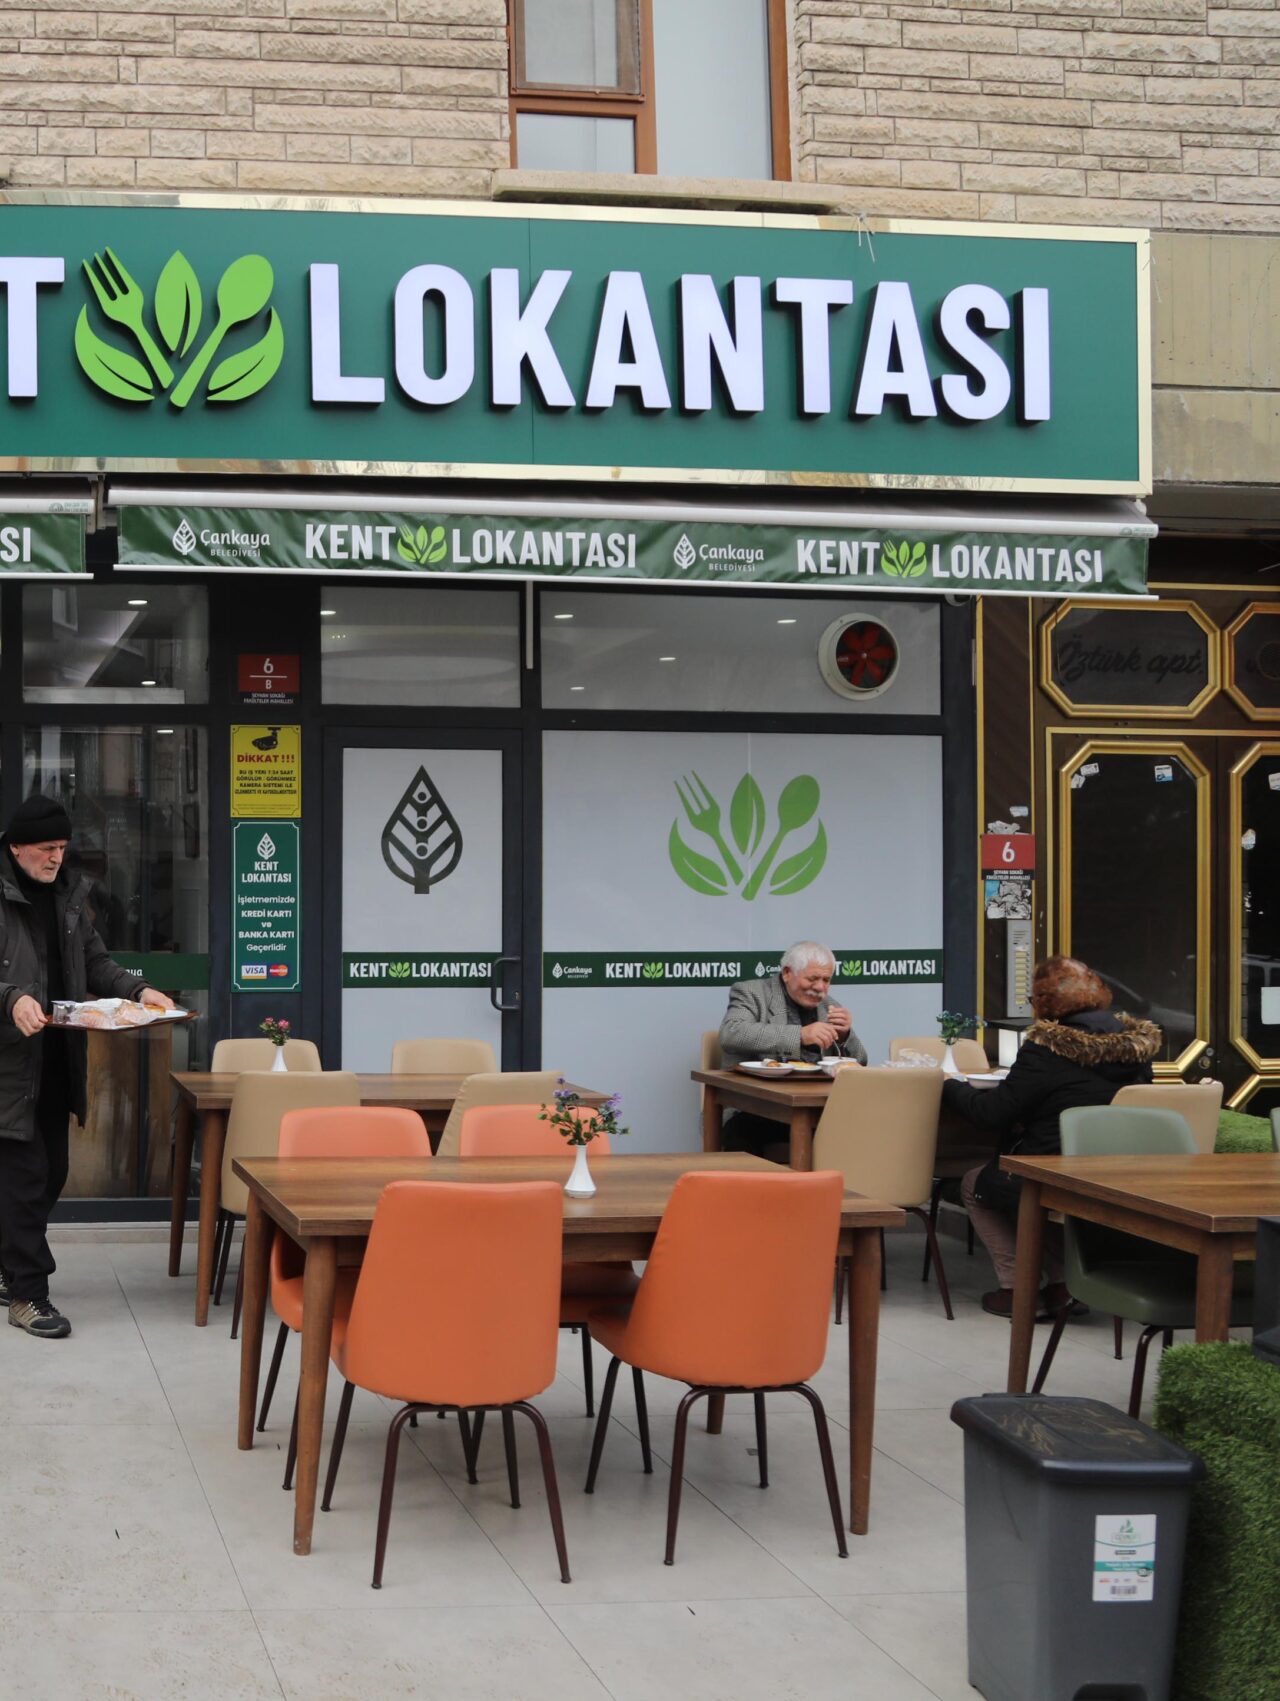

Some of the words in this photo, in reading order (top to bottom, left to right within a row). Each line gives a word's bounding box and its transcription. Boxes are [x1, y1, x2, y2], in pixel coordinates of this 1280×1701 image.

[310, 263, 1052, 422] LOKANTASI
[200, 528, 271, 548] Çankaya
[305, 523, 397, 561] KENT
[451, 528, 636, 568] LOKANTASI
[210, 548, 261, 558] BELEDİYESİ
[699, 543, 764, 564] Çankaya
[796, 539, 880, 575] KENT
[931, 544, 1104, 583] LOKANTASI
[708, 562, 756, 573] BELEDİYESİ
[263, 657, 274, 674] 6
[1055, 634, 1142, 683] Öztürk
[1147, 649, 1204, 684] apt.
[236, 752, 279, 763] DİKKAT
[282, 754, 295, 763] !!!
[1002, 841, 1015, 863] 6
[254, 861, 279, 871] KENT
[241, 873, 292, 883] LOKANTASI
[241, 908, 266, 918] KREDİ
[267, 910, 292, 918] KARTI
[246, 943, 287, 953] Geçerlidir
[245, 966, 265, 975] VISA
[349, 962, 389, 978] KENT
[411, 961, 492, 978] LOKANTASI
[605, 963, 643, 979] KENT
[664, 962, 741, 979] LOKANTASI
[862, 959, 937, 976] LOKANTASI
